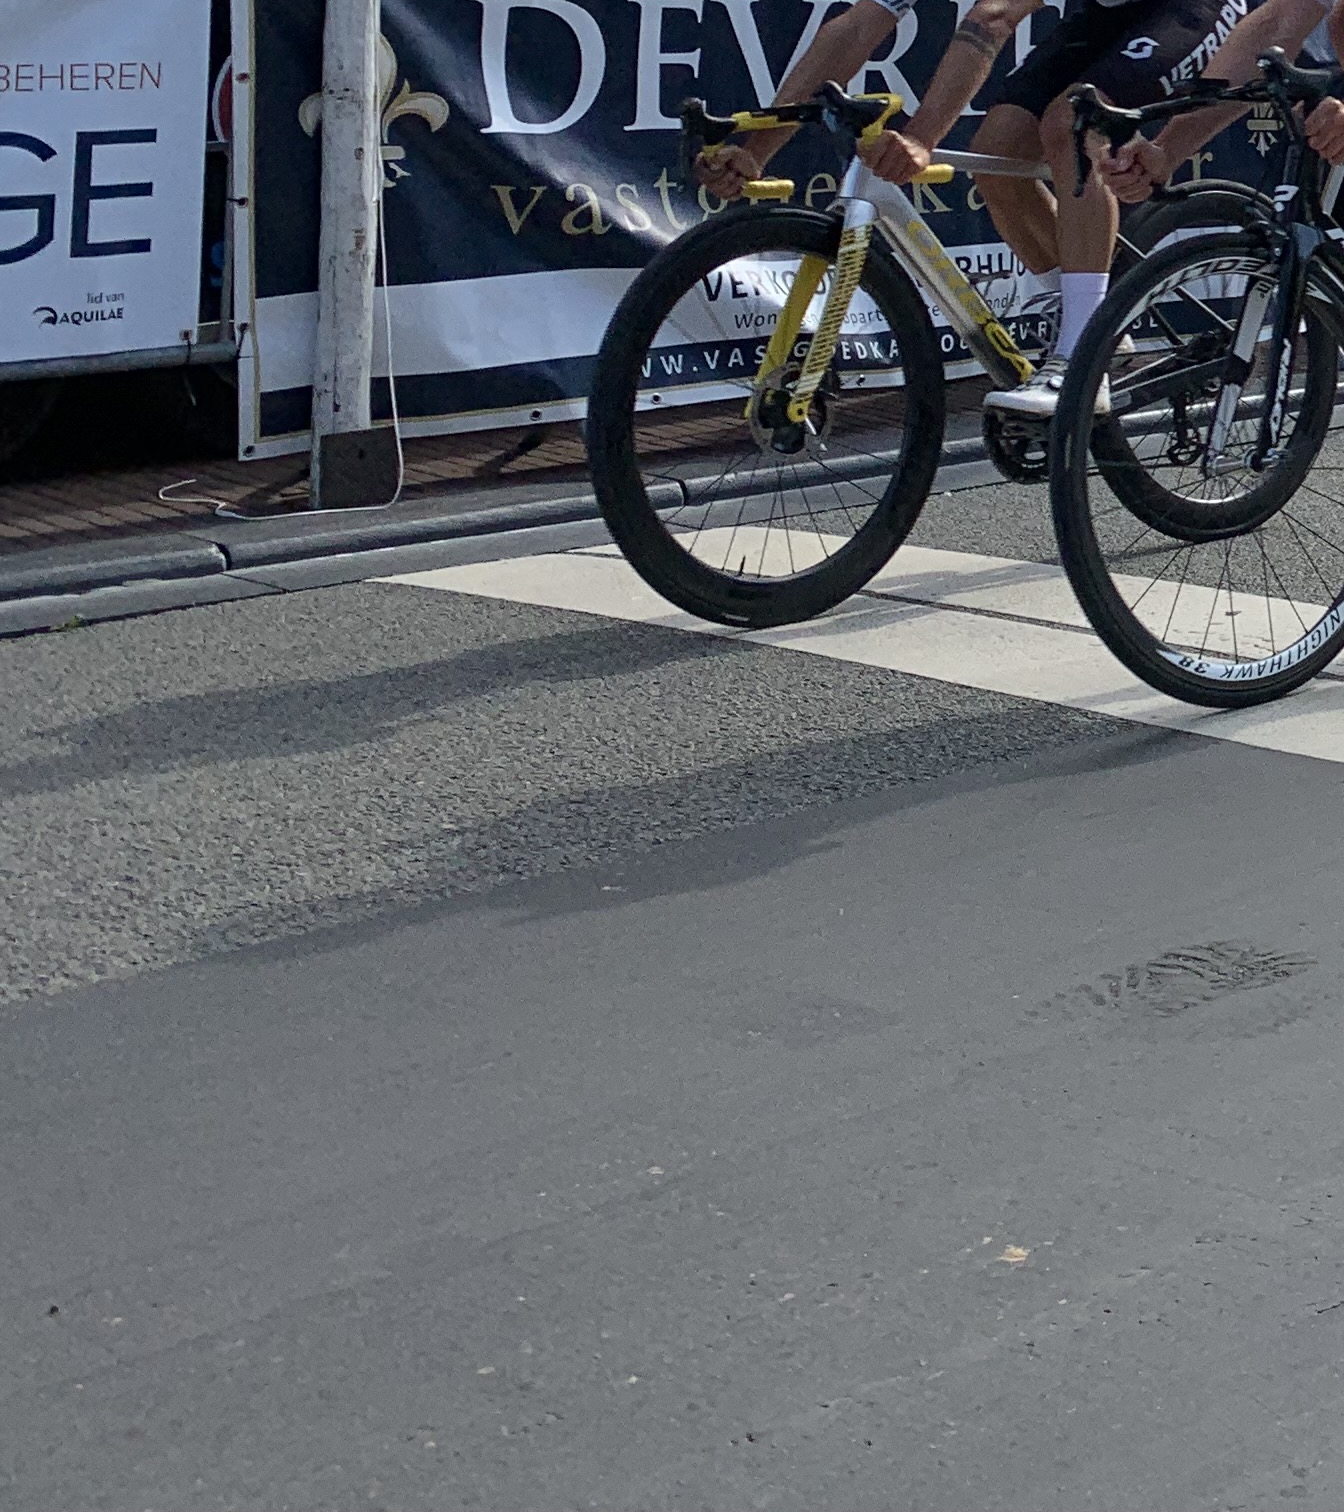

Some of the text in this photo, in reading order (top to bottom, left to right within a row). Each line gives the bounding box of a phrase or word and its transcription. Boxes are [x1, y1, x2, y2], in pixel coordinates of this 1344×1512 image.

[59, 307, 124, 326] AQUILAE
[1178, 607, 1342, 679] NIGHTHAWK 38
